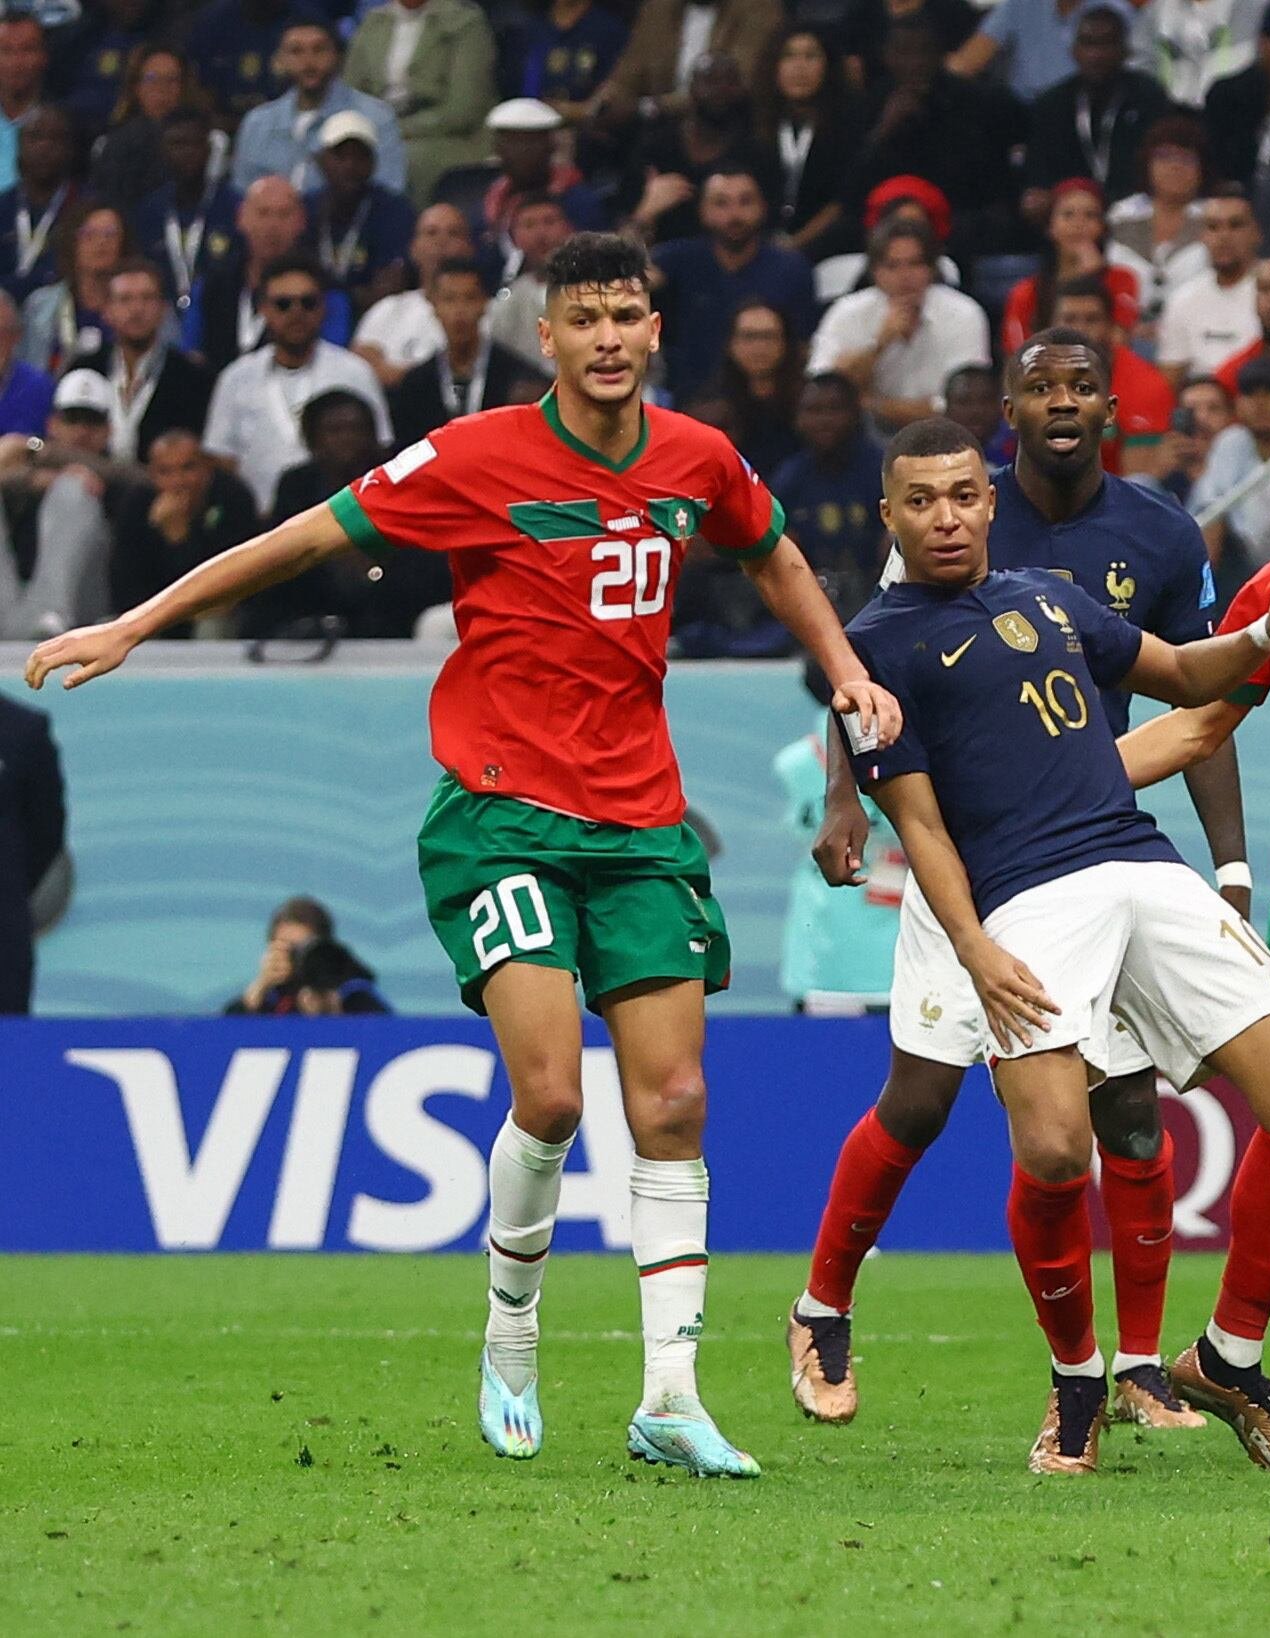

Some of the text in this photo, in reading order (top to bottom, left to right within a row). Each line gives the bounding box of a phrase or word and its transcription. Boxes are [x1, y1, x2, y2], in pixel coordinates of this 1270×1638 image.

[590, 537, 671, 621] 20
[1020, 669, 1088, 737] 10
[469, 873, 554, 971] 20
[63, 1043, 634, 1251] VISA
